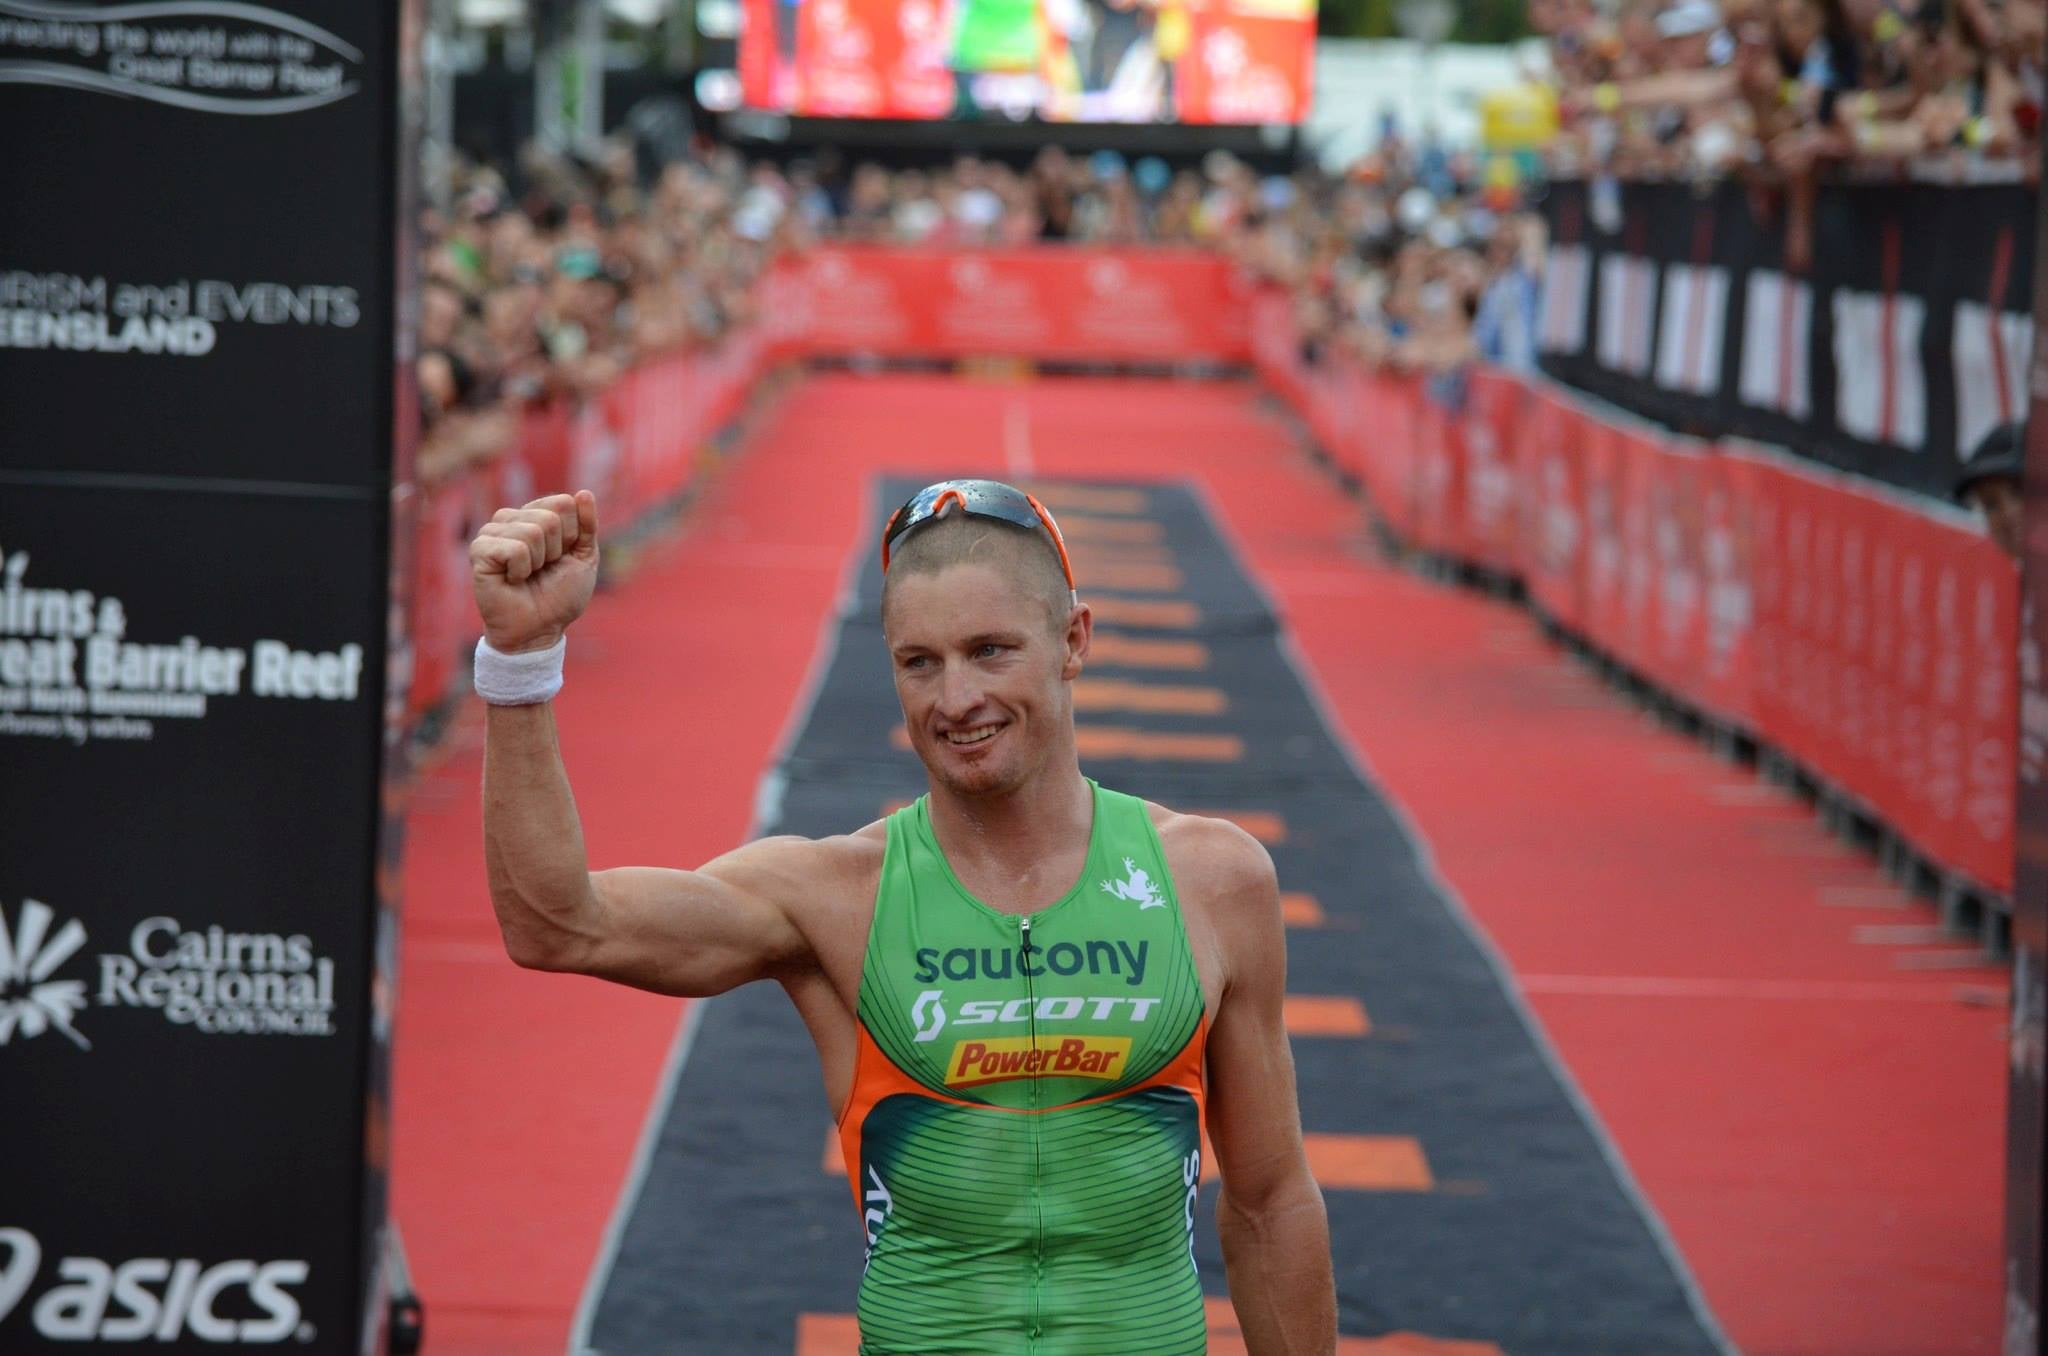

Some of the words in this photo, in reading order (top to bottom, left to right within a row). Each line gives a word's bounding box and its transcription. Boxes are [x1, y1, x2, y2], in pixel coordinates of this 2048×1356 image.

[152, 27, 226, 57] world
[113, 279, 189, 318] and
[197, 280, 360, 327] EVENTS
[0, 637, 77, 687] eat
[86, 634, 246, 695] Barrier
[252, 640, 363, 699] Reef
[131, 916, 313, 971] Cairns
[913, 940, 1149, 986] saucony
[98, 954, 334, 1023] Regional
[952, 997, 1161, 1025] SCOTT
[956, 1039, 1120, 1078] PowerBar
[33, 1257, 310, 1343] asics
